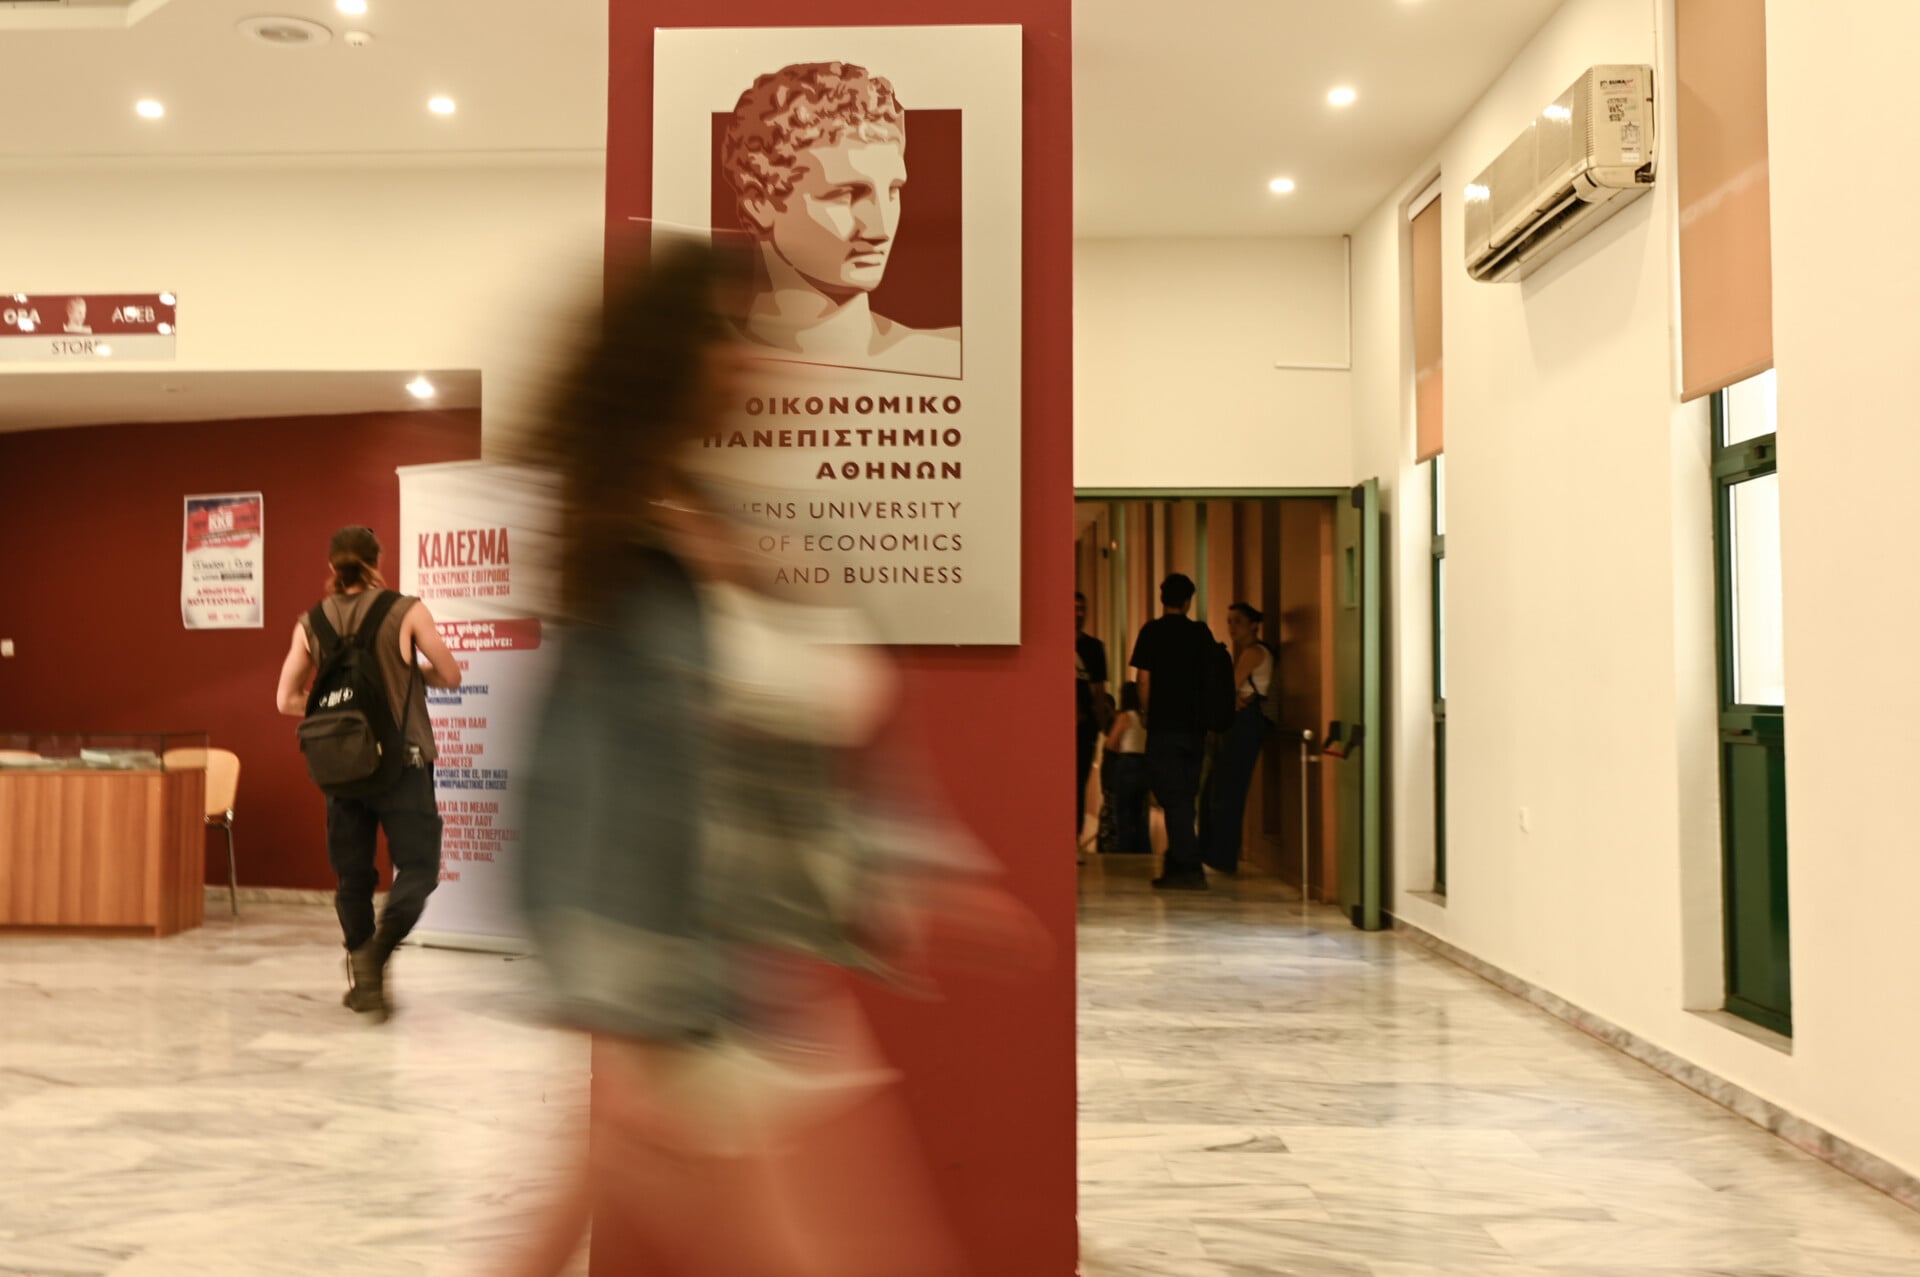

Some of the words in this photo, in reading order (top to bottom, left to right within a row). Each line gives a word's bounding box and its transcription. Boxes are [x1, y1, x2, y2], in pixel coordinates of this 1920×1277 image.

[52, 340, 103, 355] STOR
[745, 395, 962, 416] ΟΙΚΟΝΟΜΙΚΟ
[703, 428, 962, 448] ΠΑΝΕΠΙΣΤΗΜΙΟ
[816, 461, 962, 480] ΑΘΗΝΩΝ
[743, 503, 796, 519] ENS
[809, 502, 962, 519] UNIVERSITY
[418, 528, 510, 568] ΚΑΛΕΣΜΑ
[759, 535, 790, 552] OF
[804, 534, 962, 551] ECONOMICS
[775, 567, 830, 584] AND
[844, 566, 962, 584] BUSINESS
[456, 619, 495, 637] ψήφος
[462, 636, 513, 651] σημαίνει:
